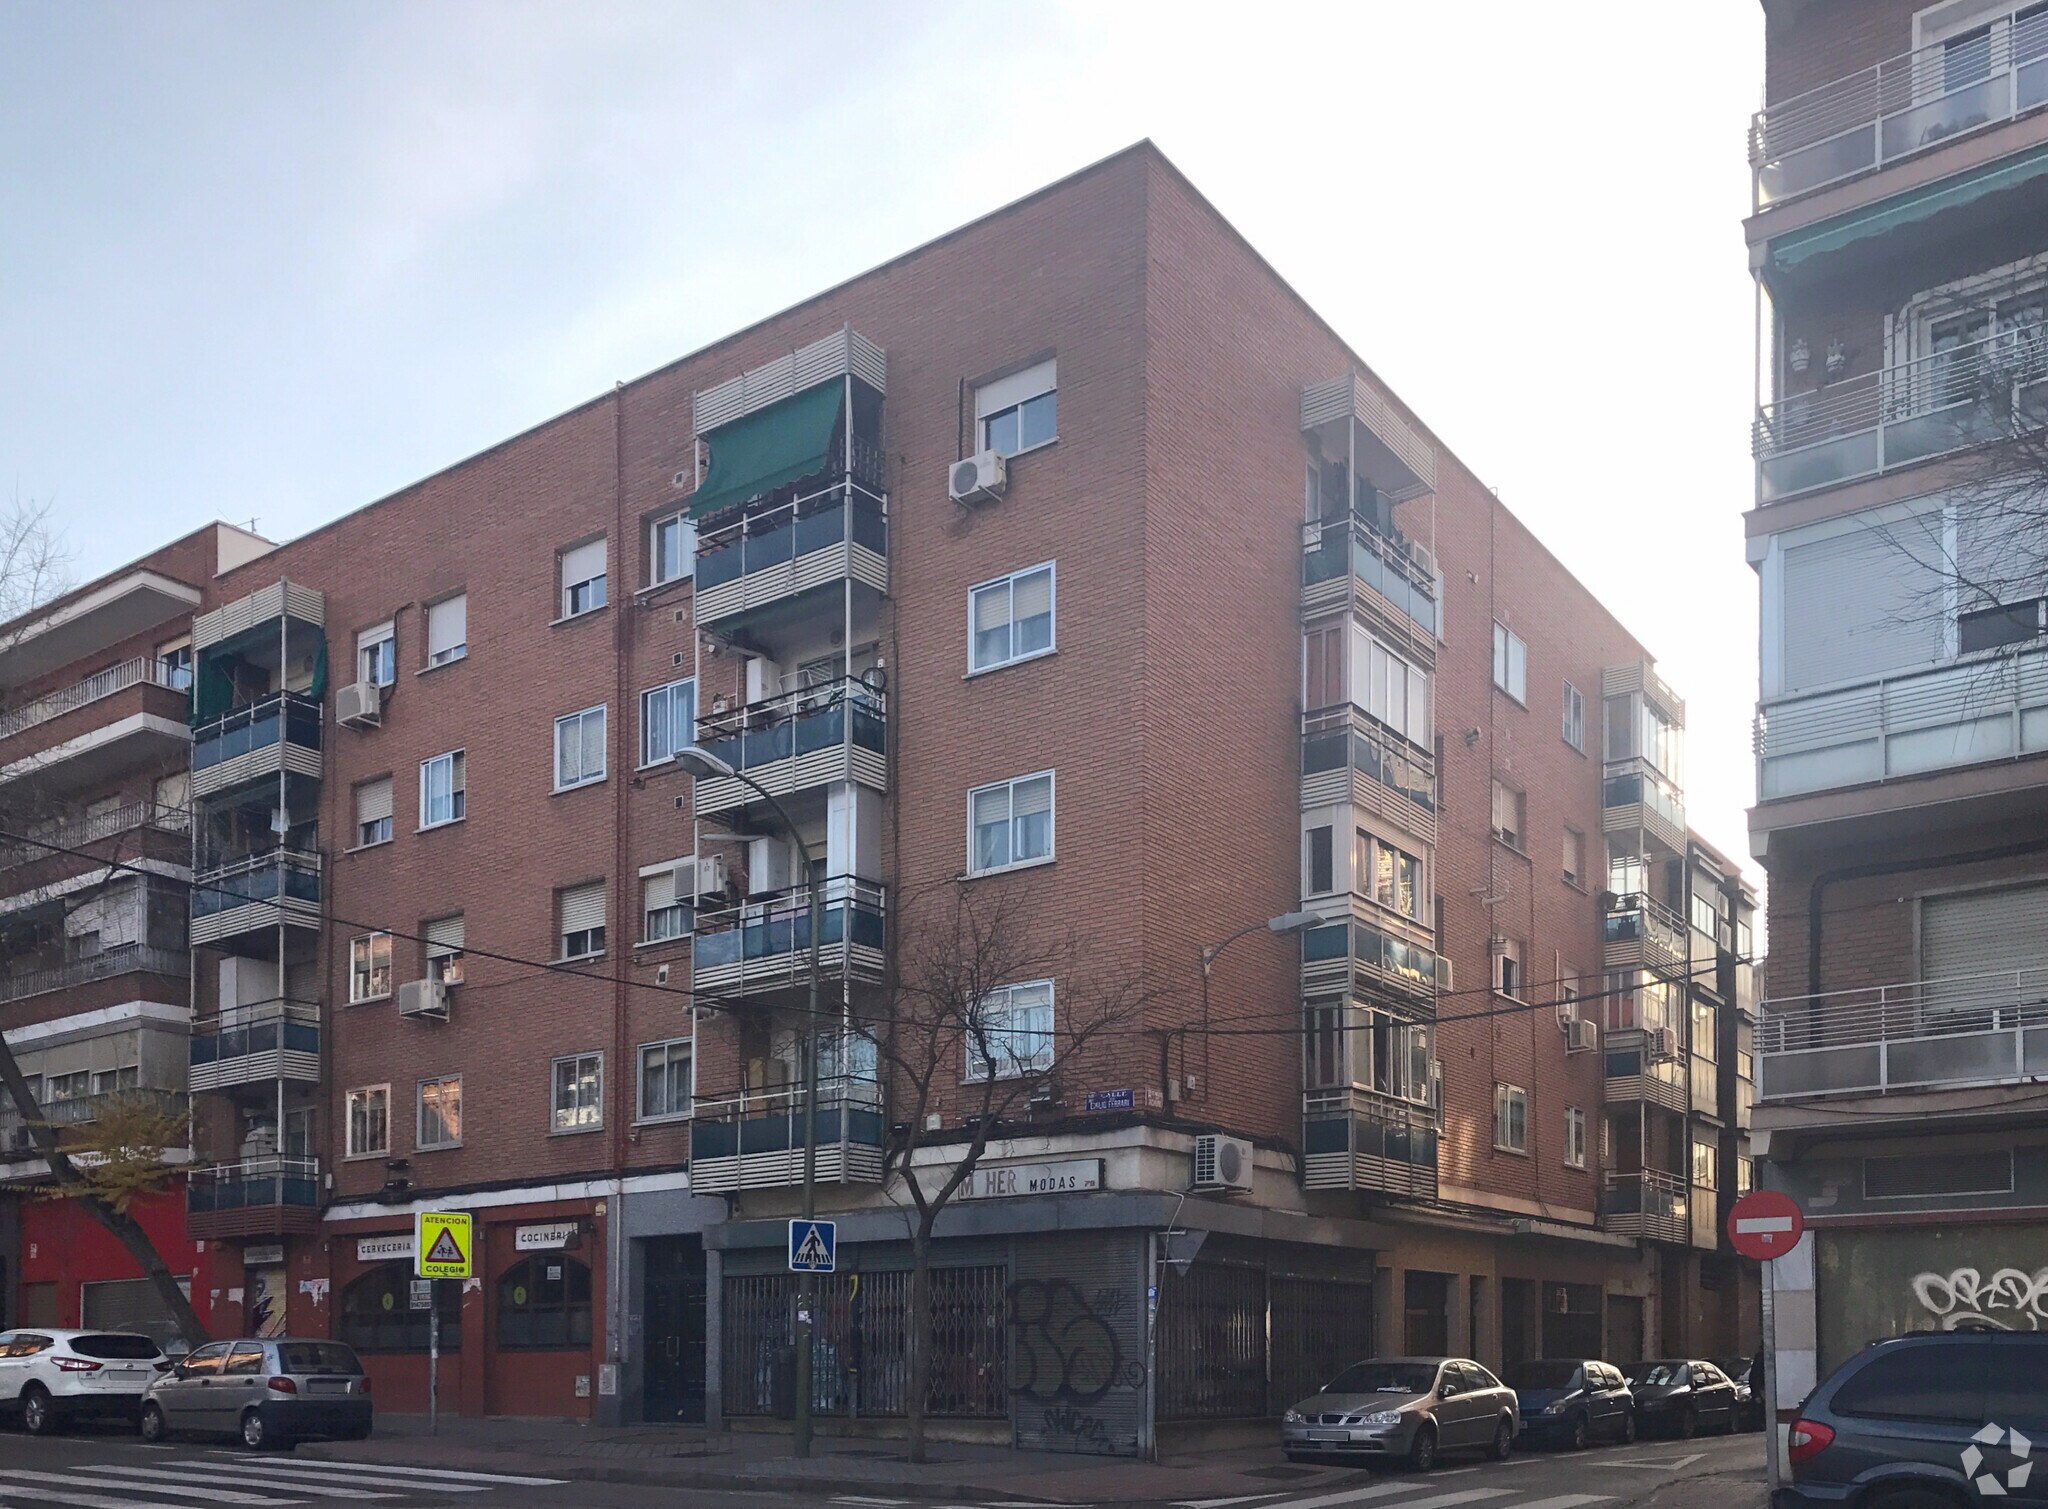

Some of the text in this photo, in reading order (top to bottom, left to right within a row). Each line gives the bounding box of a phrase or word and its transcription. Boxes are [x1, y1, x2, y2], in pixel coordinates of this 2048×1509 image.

[986, 1170, 1017, 1194] HER
[1029, 1176, 1076, 1191] MODAS
[361, 1243, 411, 1253] CERVECERIA
[425, 1265, 465, 1274] COLEGIO
